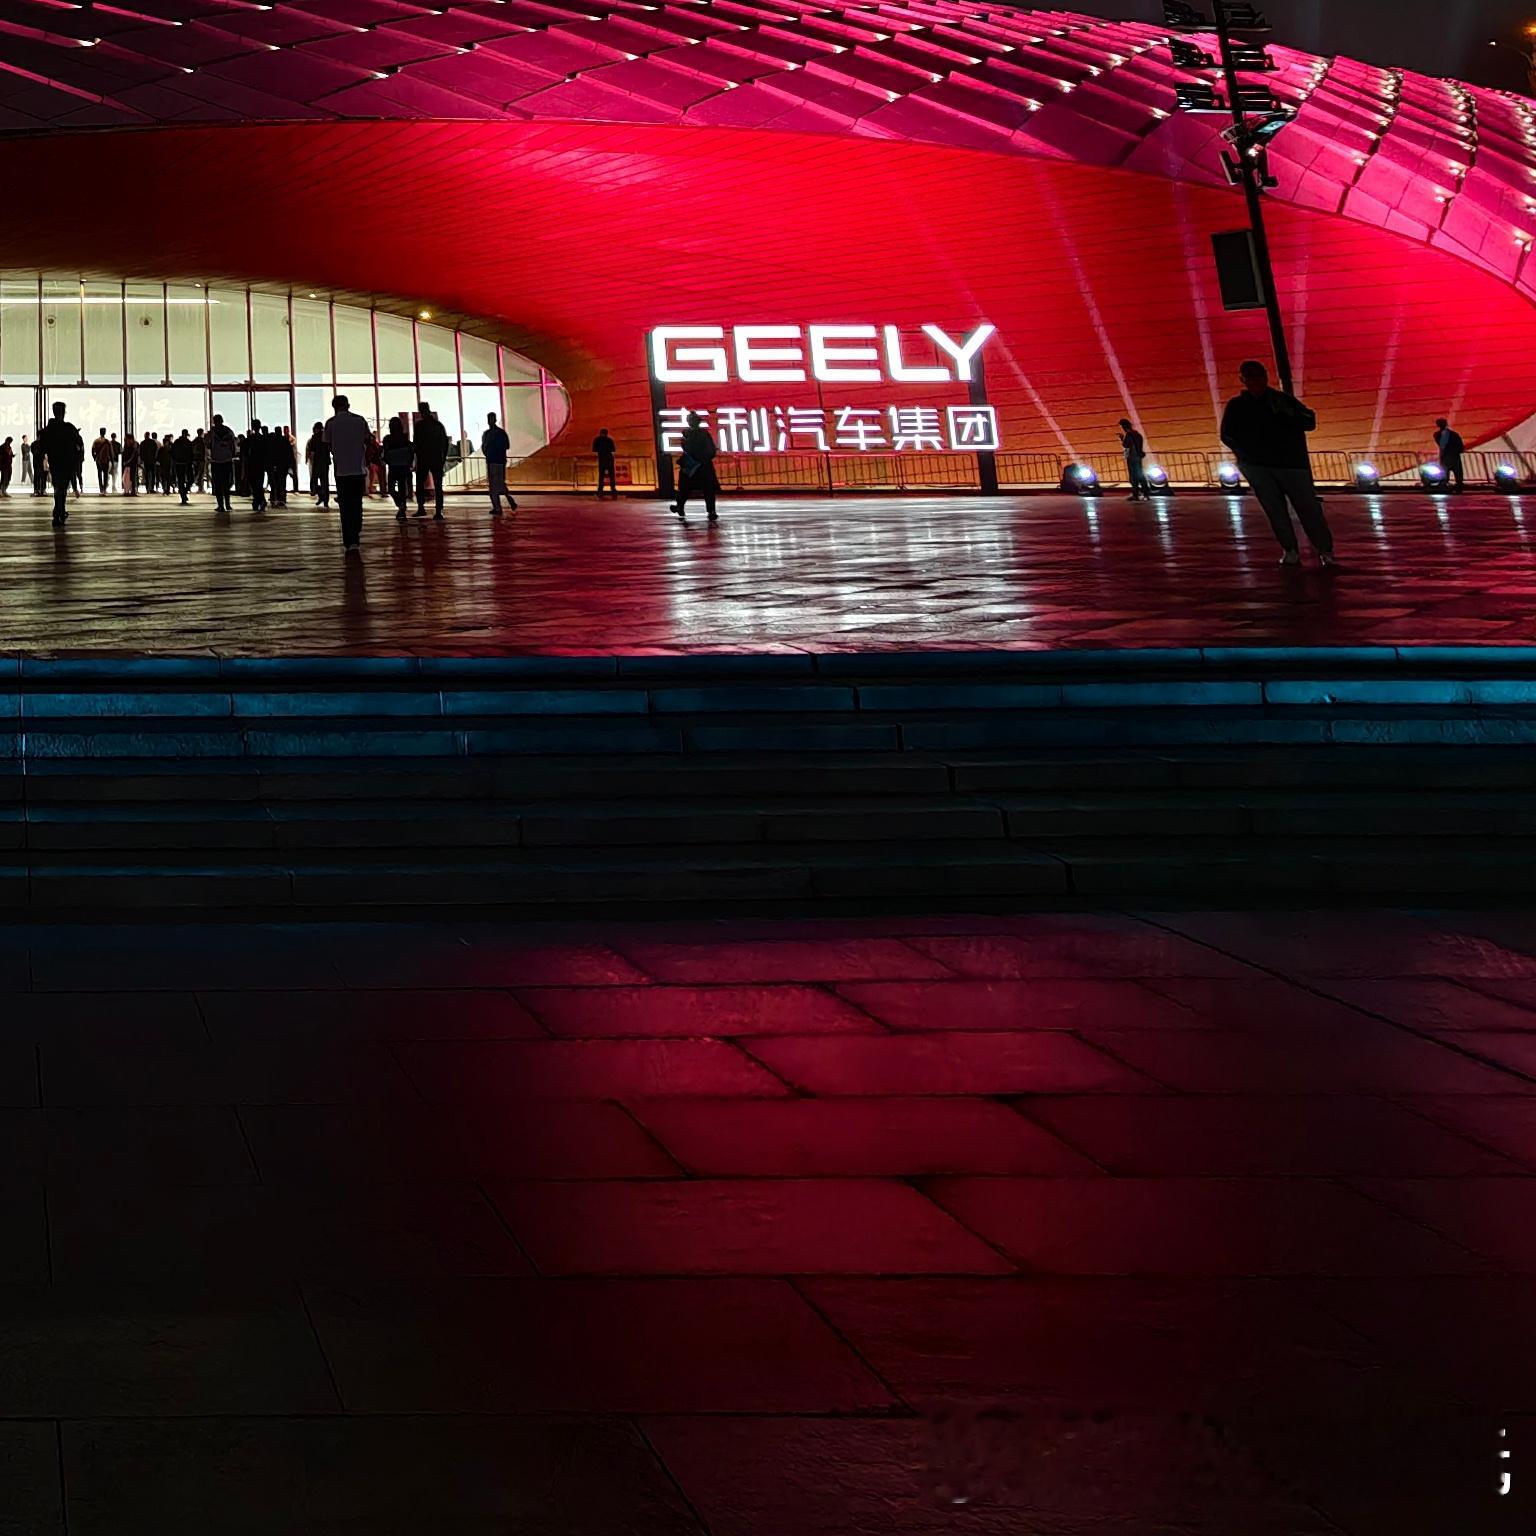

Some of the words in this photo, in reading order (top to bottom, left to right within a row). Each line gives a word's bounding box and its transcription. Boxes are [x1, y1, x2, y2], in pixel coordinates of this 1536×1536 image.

[652, 325, 995, 382] GEELY
[659, 407, 999, 451] 吉利汽车集团
